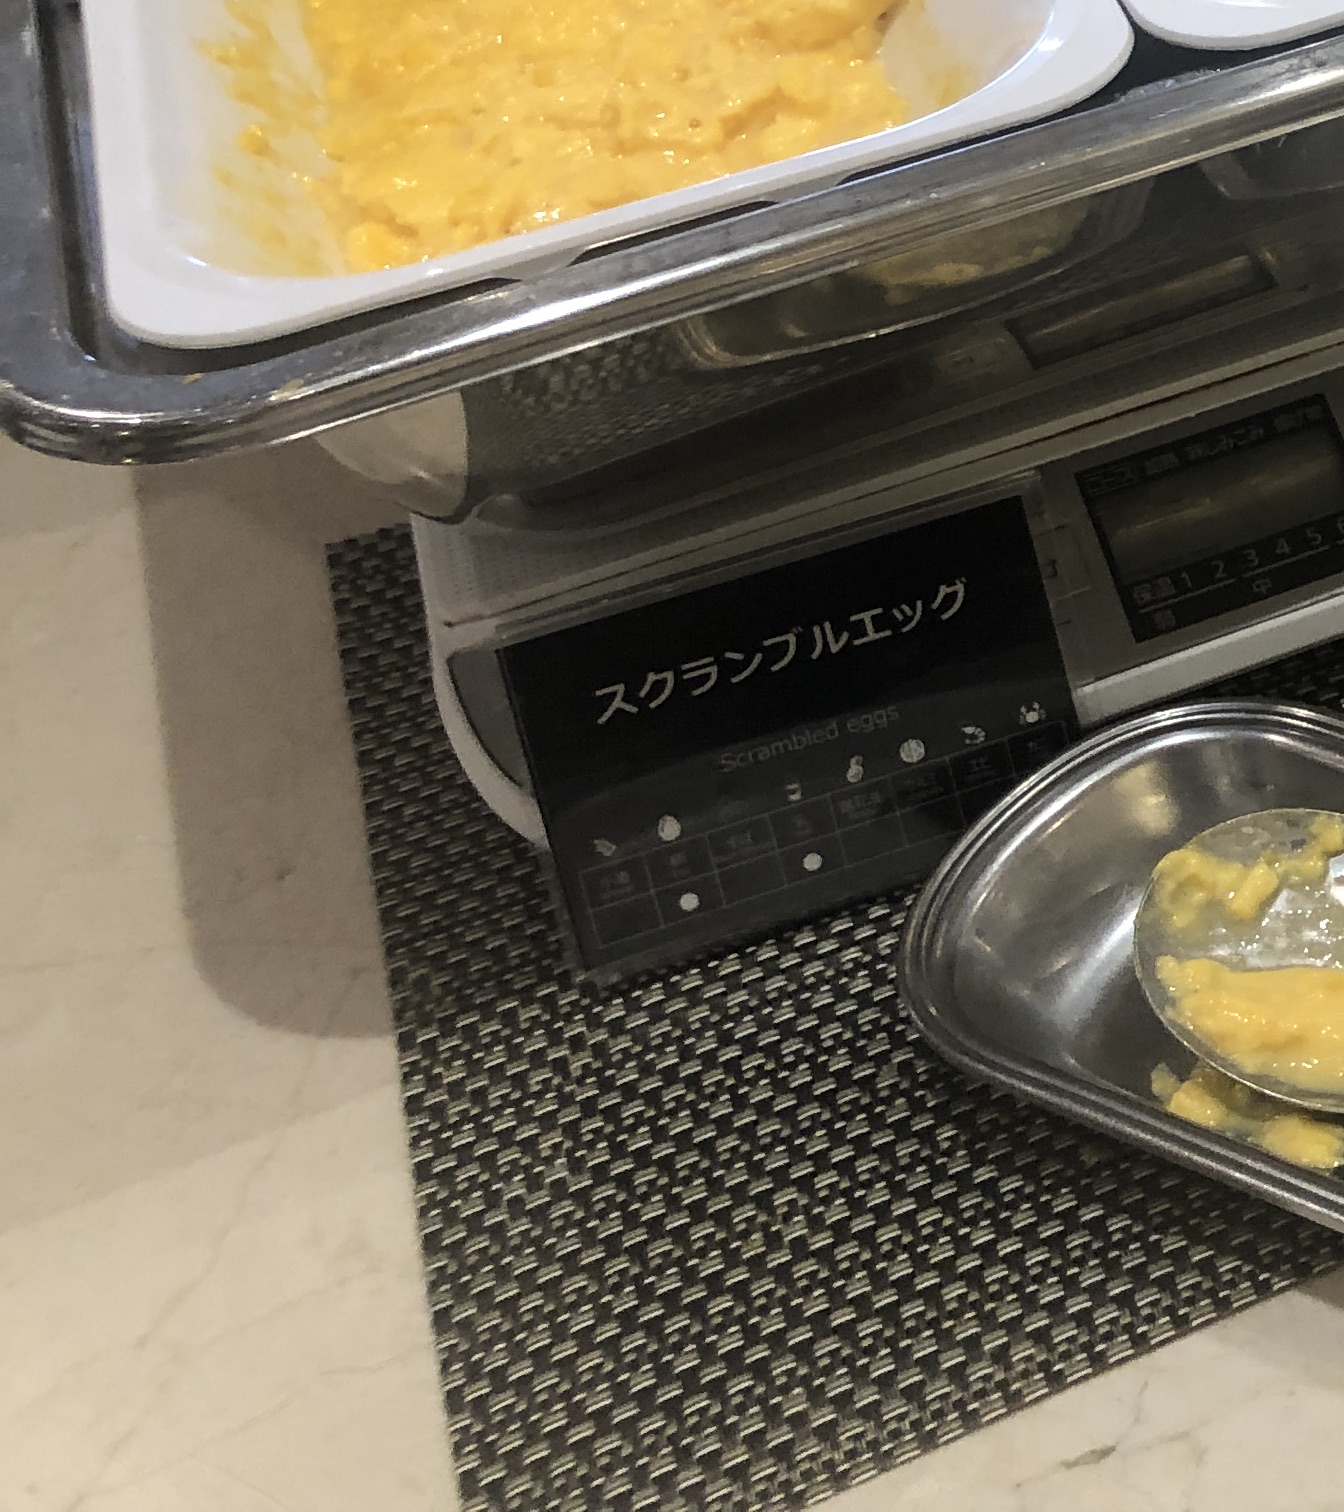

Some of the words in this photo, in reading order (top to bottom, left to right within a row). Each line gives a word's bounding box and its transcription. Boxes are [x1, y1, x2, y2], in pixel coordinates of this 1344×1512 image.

[1213, 560, 1227, 579] 2
[1244, 549, 1259, 568] 3
[1275, 538, 1290, 557] 4
[1306, 526, 1322, 545] 5
[595, 577, 967, 724] スクランブルエッグ
[719, 720, 839, 773] Scrambled
[846, 703, 899, 736] eggs
